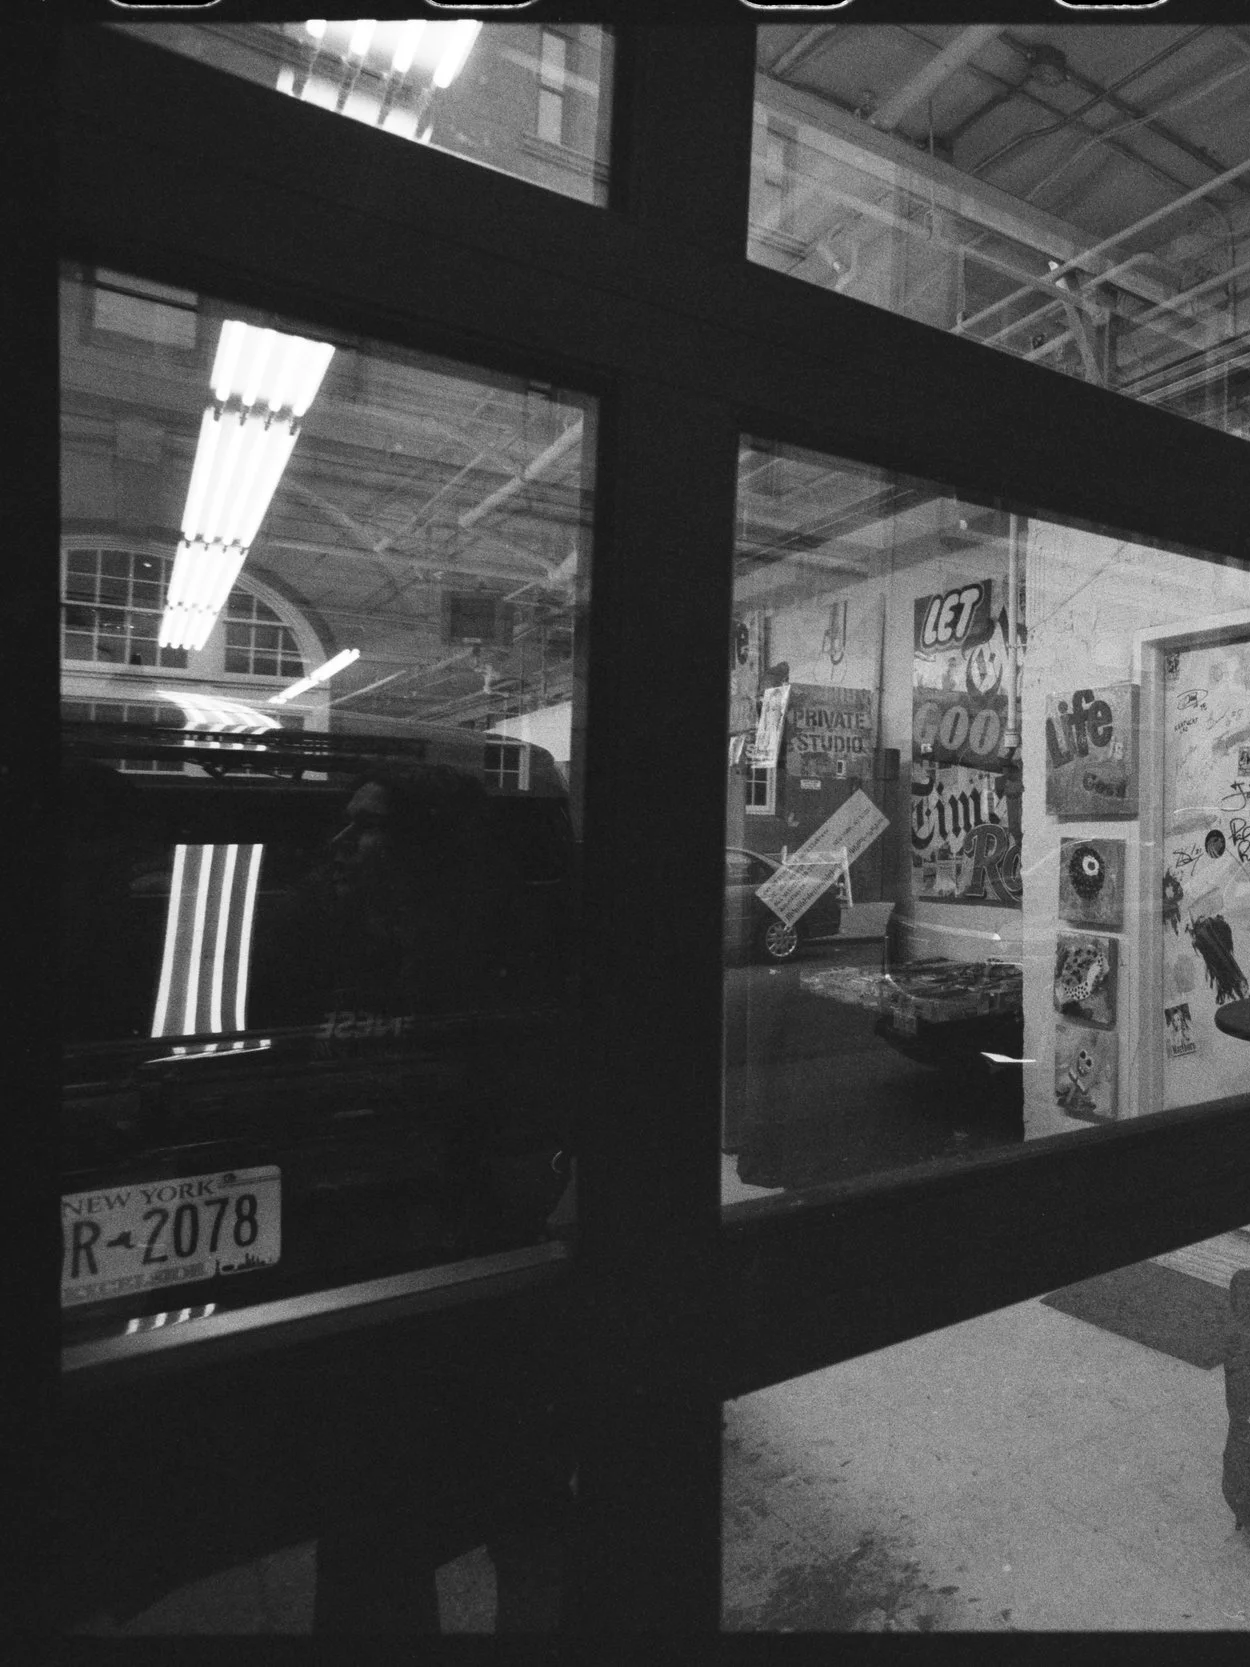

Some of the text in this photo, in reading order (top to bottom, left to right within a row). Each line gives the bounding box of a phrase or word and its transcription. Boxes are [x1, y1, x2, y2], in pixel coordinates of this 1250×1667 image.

[923, 586, 981, 646] LET
[792, 708, 867, 731] PRIVATE
[1046, 688, 1114, 769] Life
[796, 734, 865, 754] STUDIO
[62, 1179, 217, 1216] NEW YORK
